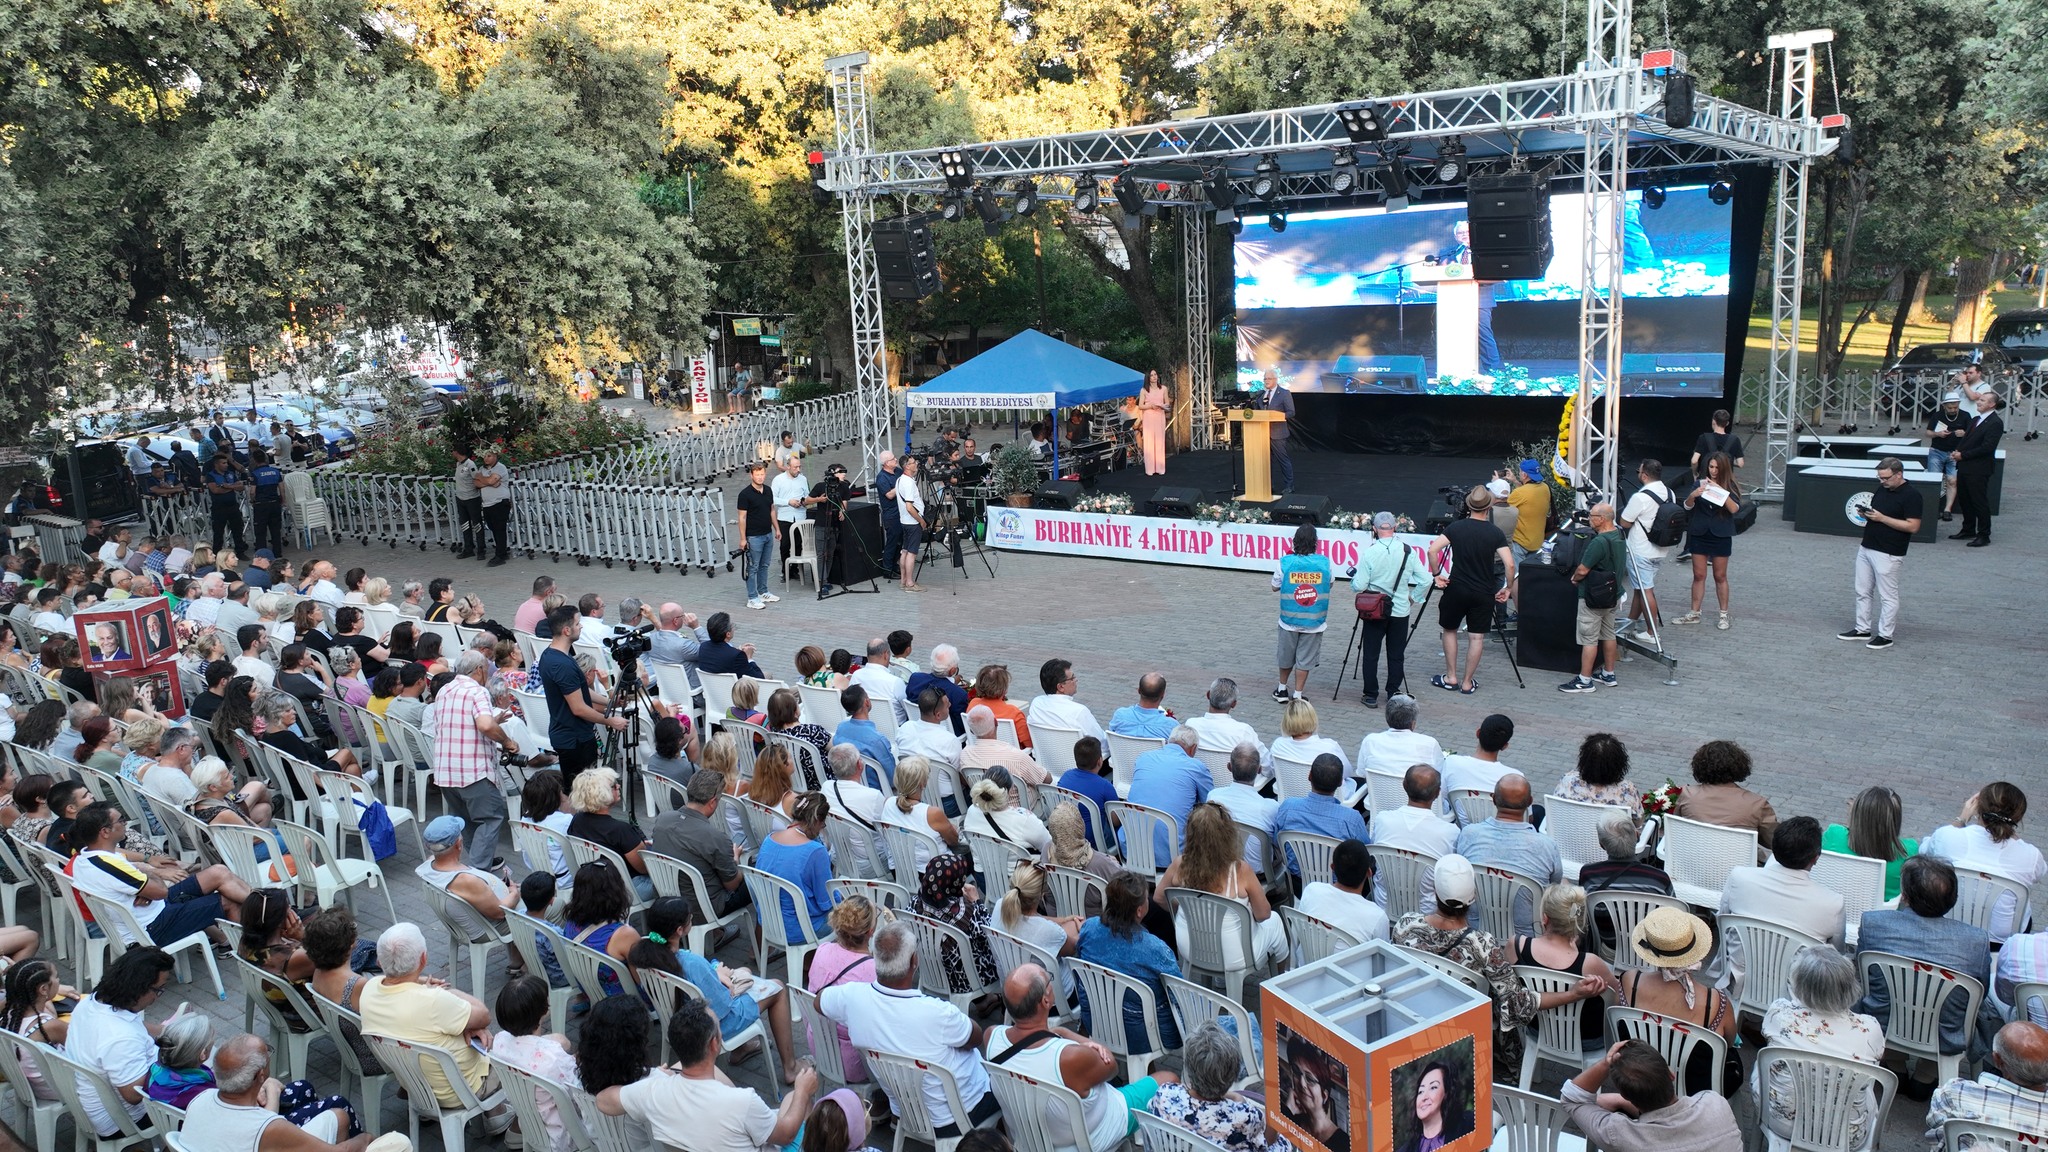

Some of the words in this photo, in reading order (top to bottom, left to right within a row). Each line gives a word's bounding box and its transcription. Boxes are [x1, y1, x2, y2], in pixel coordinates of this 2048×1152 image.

[926, 395, 978, 406] BURHANİYE
[980, 395, 1034, 407] BELEDİYESİ
[1035, 518, 1132, 549] BURHANİYE
[1221, 532, 1294, 560] FUARIN
[1291, 572, 1321, 580] PRESS
[1296, 592, 1317, 600] HABER
[1487, 867, 1514, 880] NC
[1307, 915, 1333, 930] NC
[1642, 1012, 1691, 1034] NC
[868, 1050, 928, 1070] NC
[1270, 1110, 1287, 1129] Buket
[1288, 1124, 1314, 1149] UZUNER
